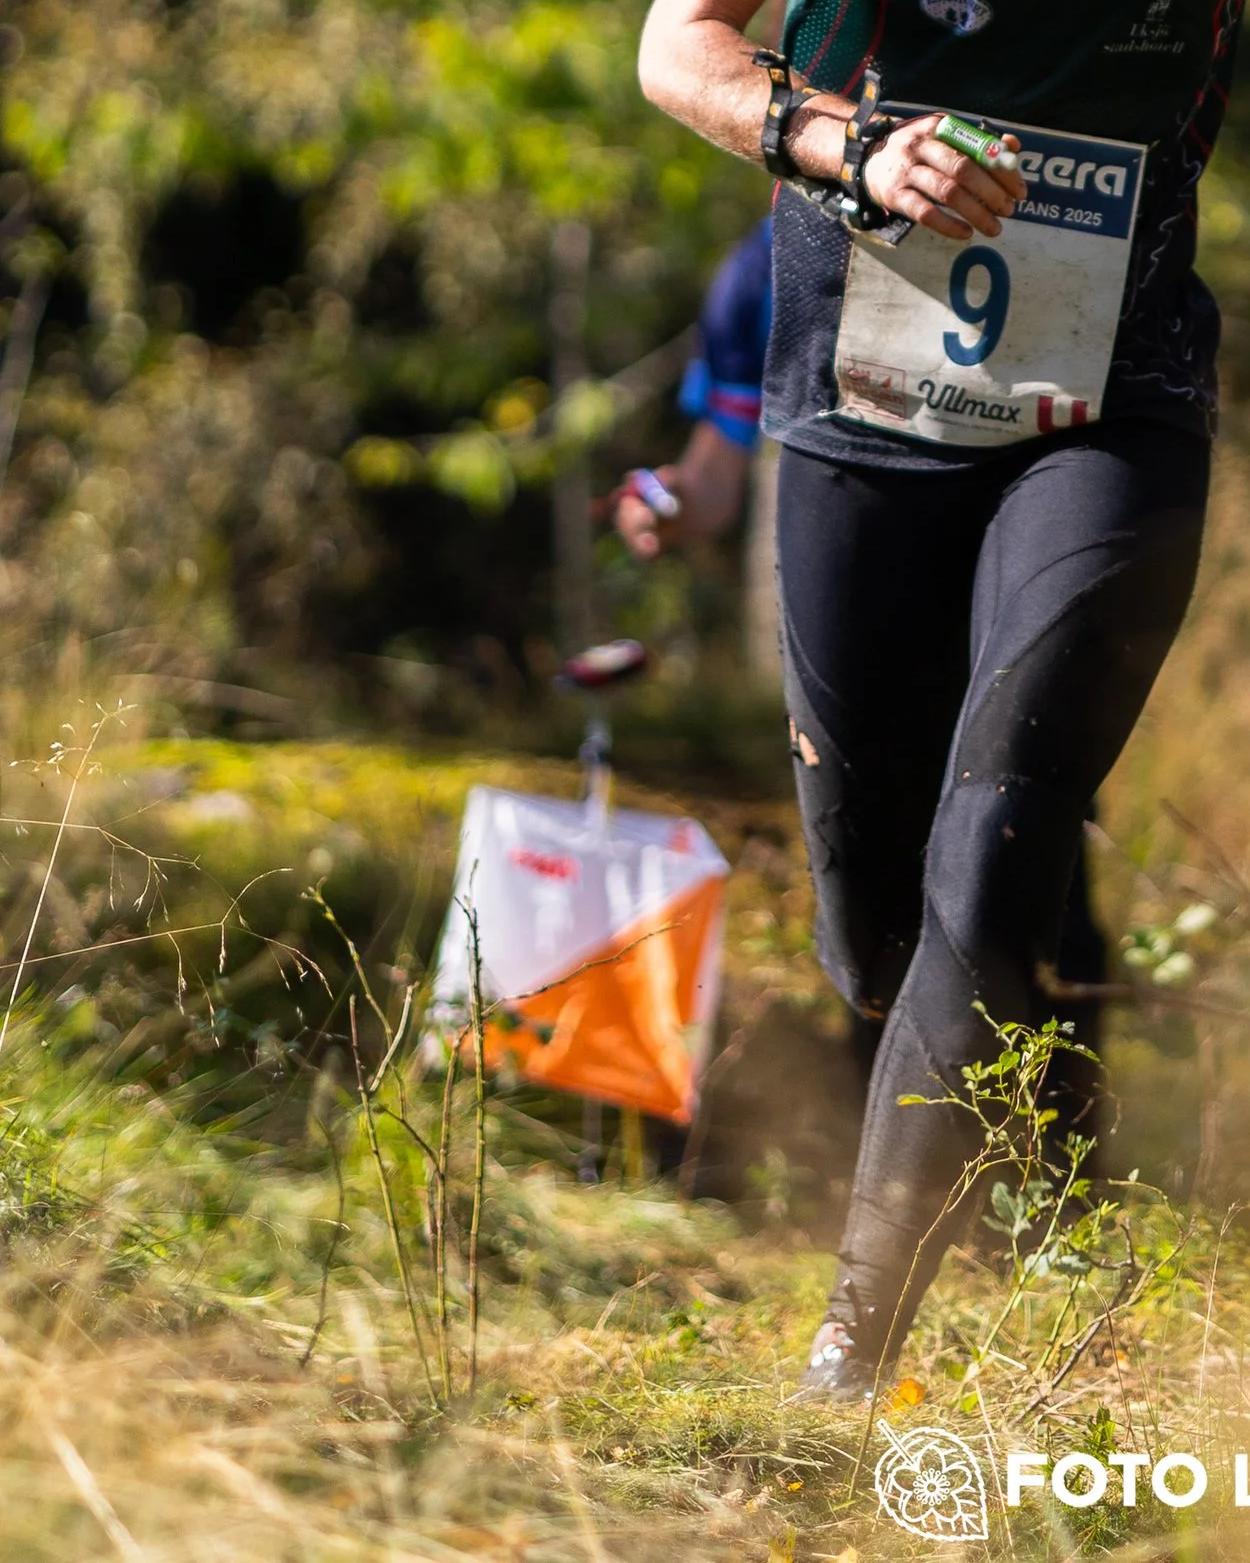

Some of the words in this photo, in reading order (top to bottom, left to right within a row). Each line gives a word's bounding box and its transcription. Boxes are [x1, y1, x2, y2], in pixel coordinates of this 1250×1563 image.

[1015, 198, 1063, 221] TANS
[1065, 208, 1104, 226] 2025
[943, 245, 1010, 366] 9
[917, 379, 1021, 423] Ullmax
